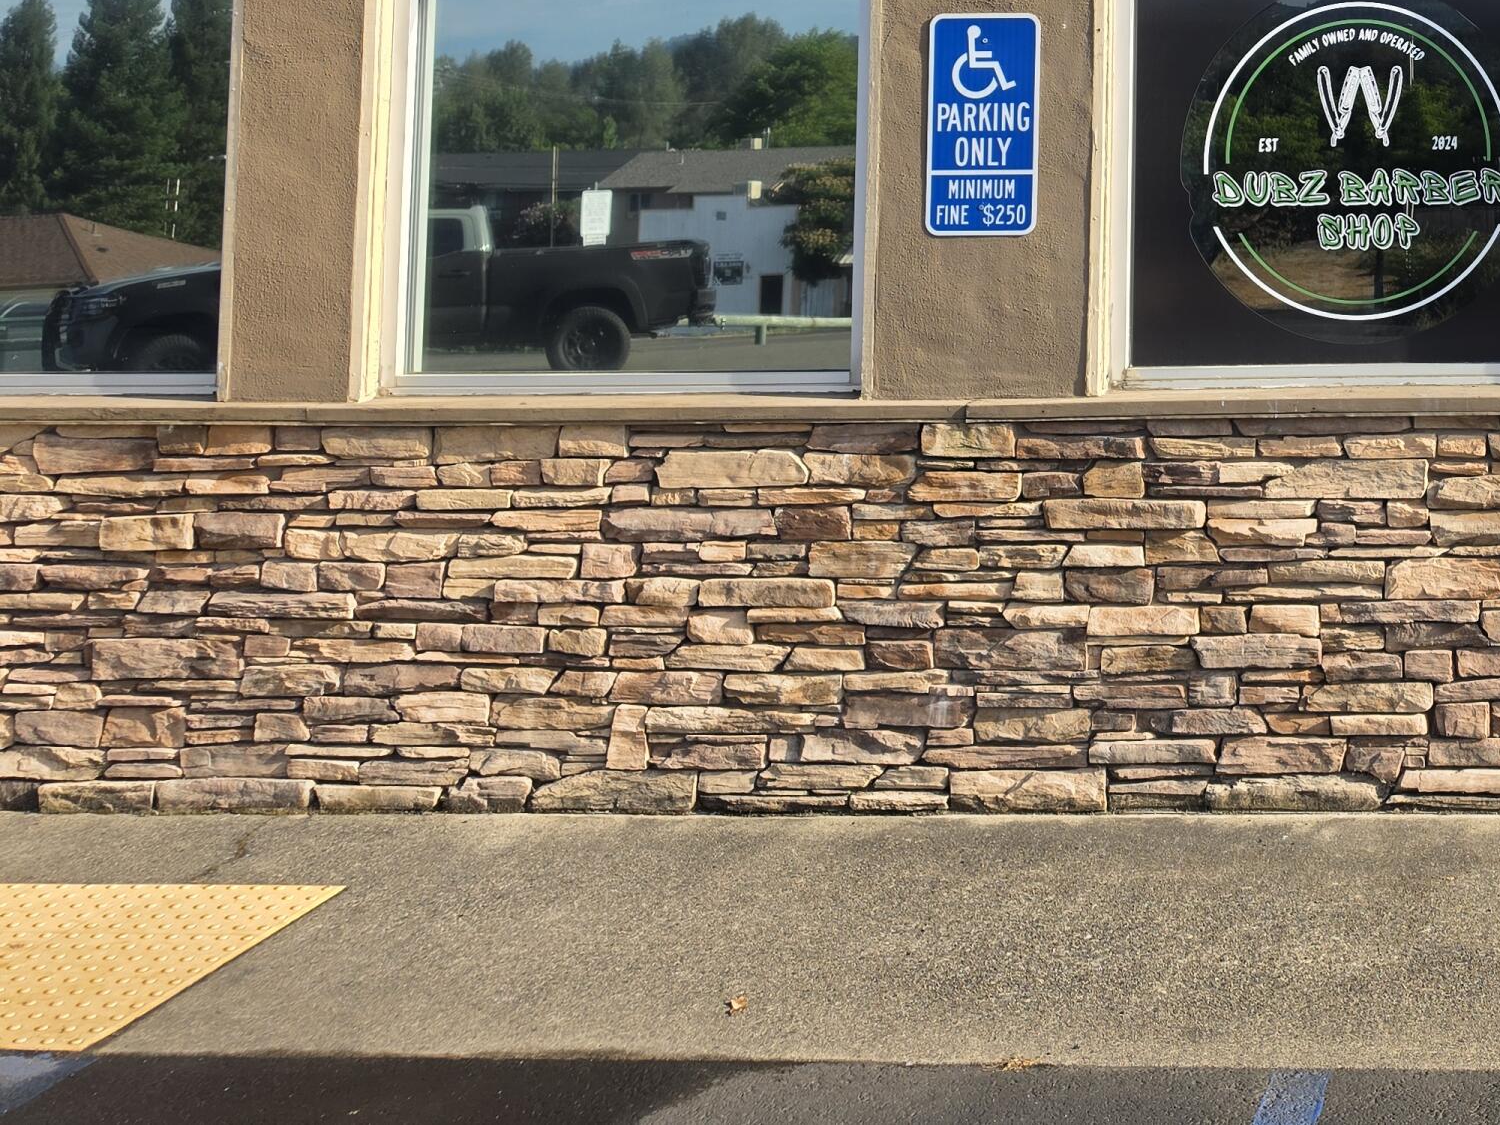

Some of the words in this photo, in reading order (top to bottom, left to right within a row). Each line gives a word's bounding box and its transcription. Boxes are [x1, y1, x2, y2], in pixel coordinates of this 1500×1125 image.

[1288, 38, 1320, 66] FAMILY
[1321, 28, 1356, 47] OWNED
[1358, 28, 1378, 41] AND
[1380, 31, 1426, 61] OPERATED
[937, 101, 1030, 132] PARKING
[954, 137, 1012, 167] ONLY
[1258, 137, 1279, 153] EST
[1431, 136, 1458, 151] 2024
[948, 179, 1016, 200] MINIMUM
[1213, 170, 1331, 207] DUBZ
[936, 205, 969, 226] FINE
[982, 203, 1026, 226] $250
[1317, 213, 1420, 250] SHOP
